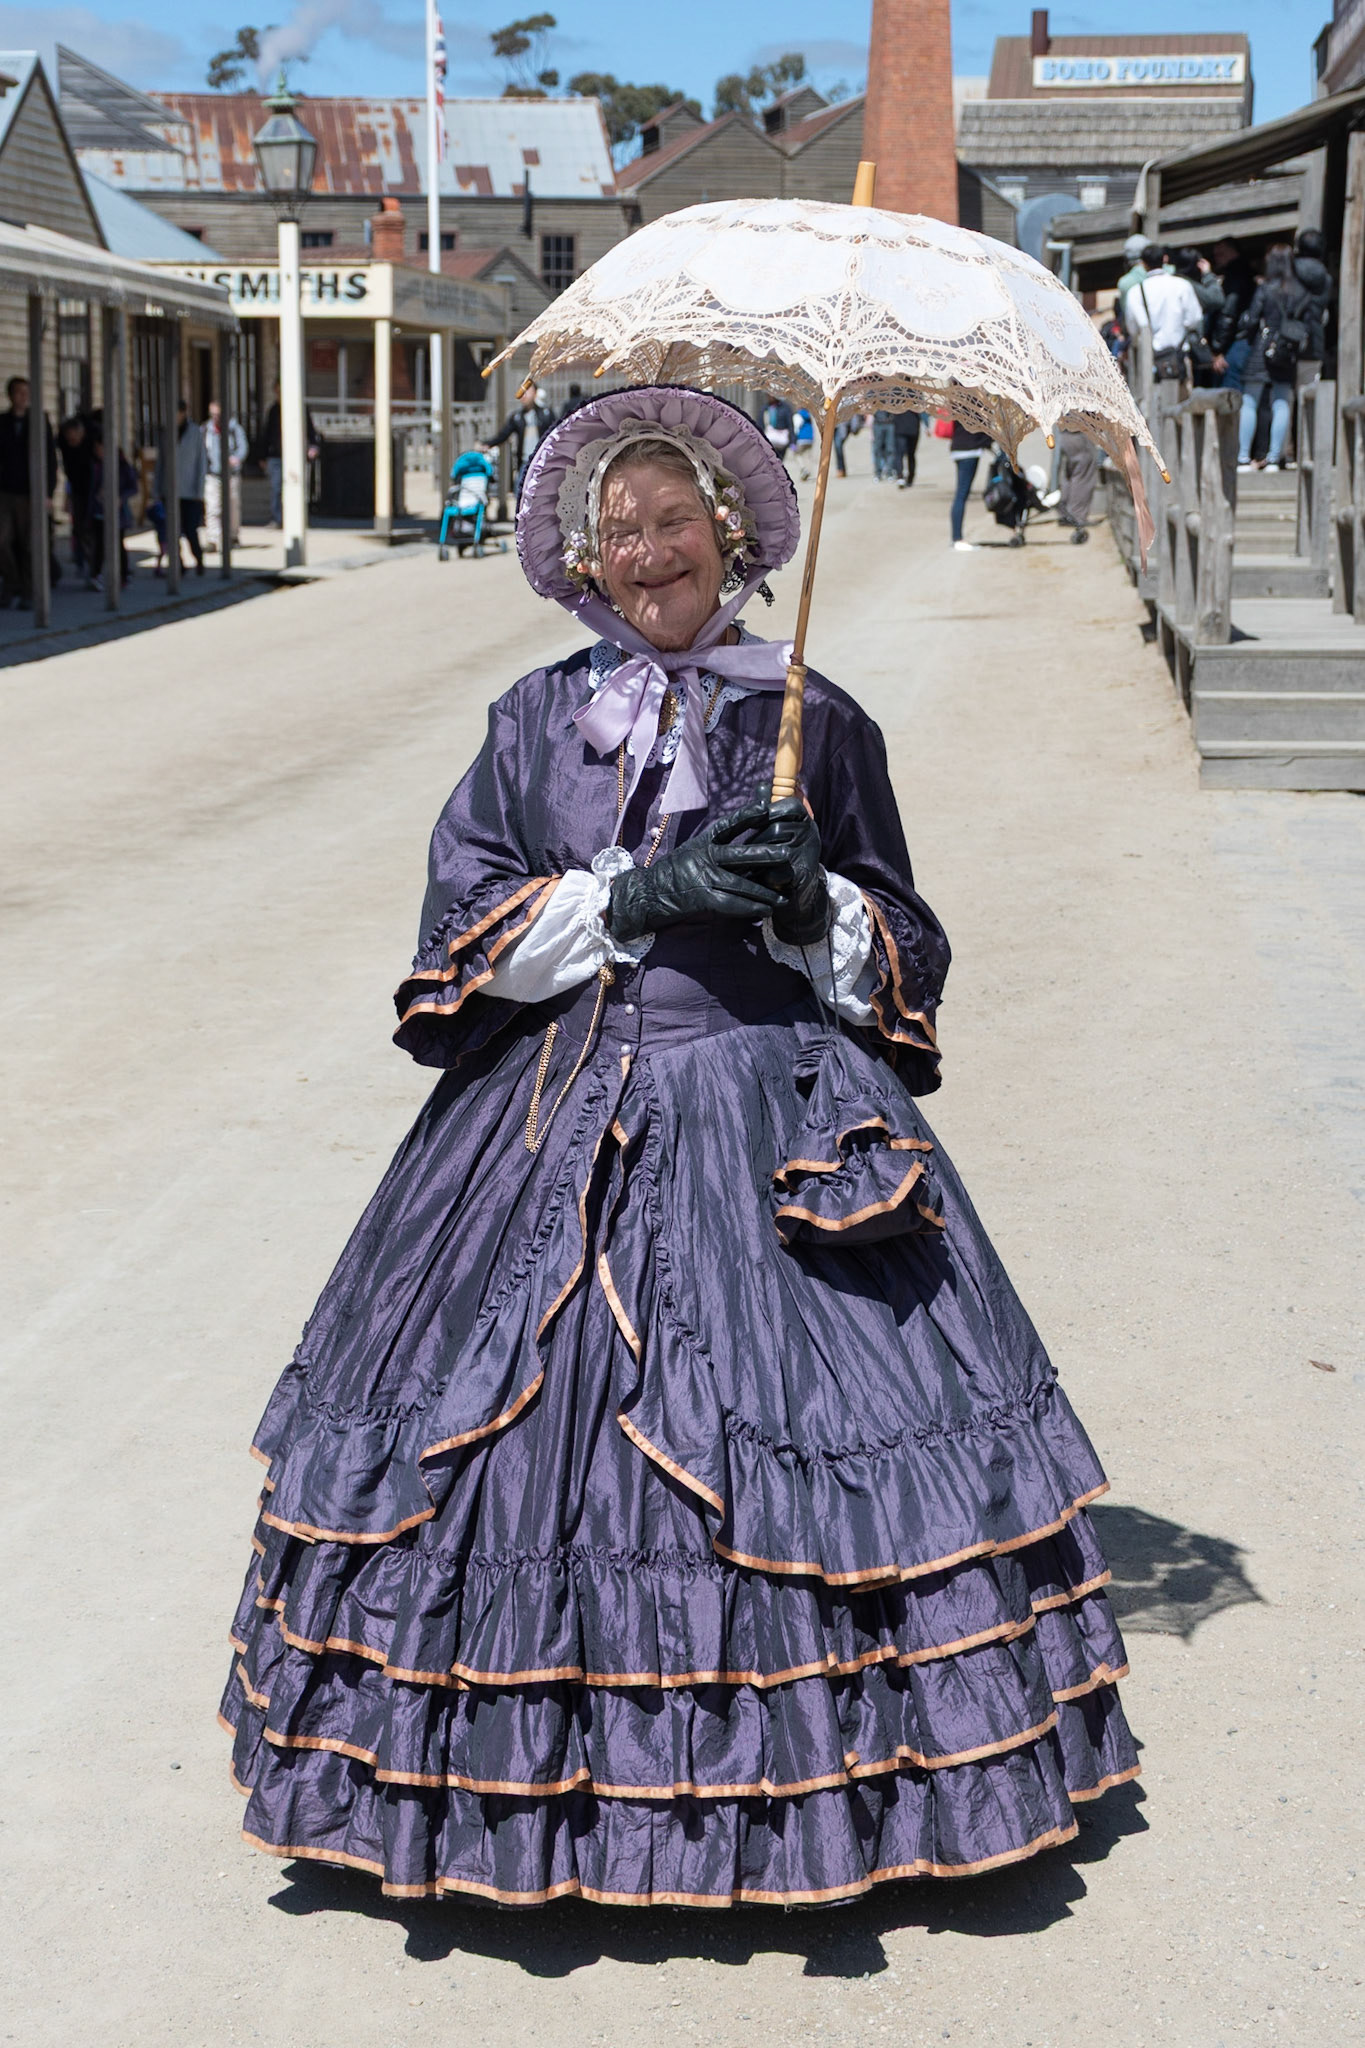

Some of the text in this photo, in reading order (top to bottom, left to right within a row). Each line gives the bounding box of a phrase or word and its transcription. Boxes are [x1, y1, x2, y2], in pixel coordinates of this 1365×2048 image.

[1043, 57, 1236, 80] SOHO FOUNDRY
[187, 272, 367, 299] SMHS
